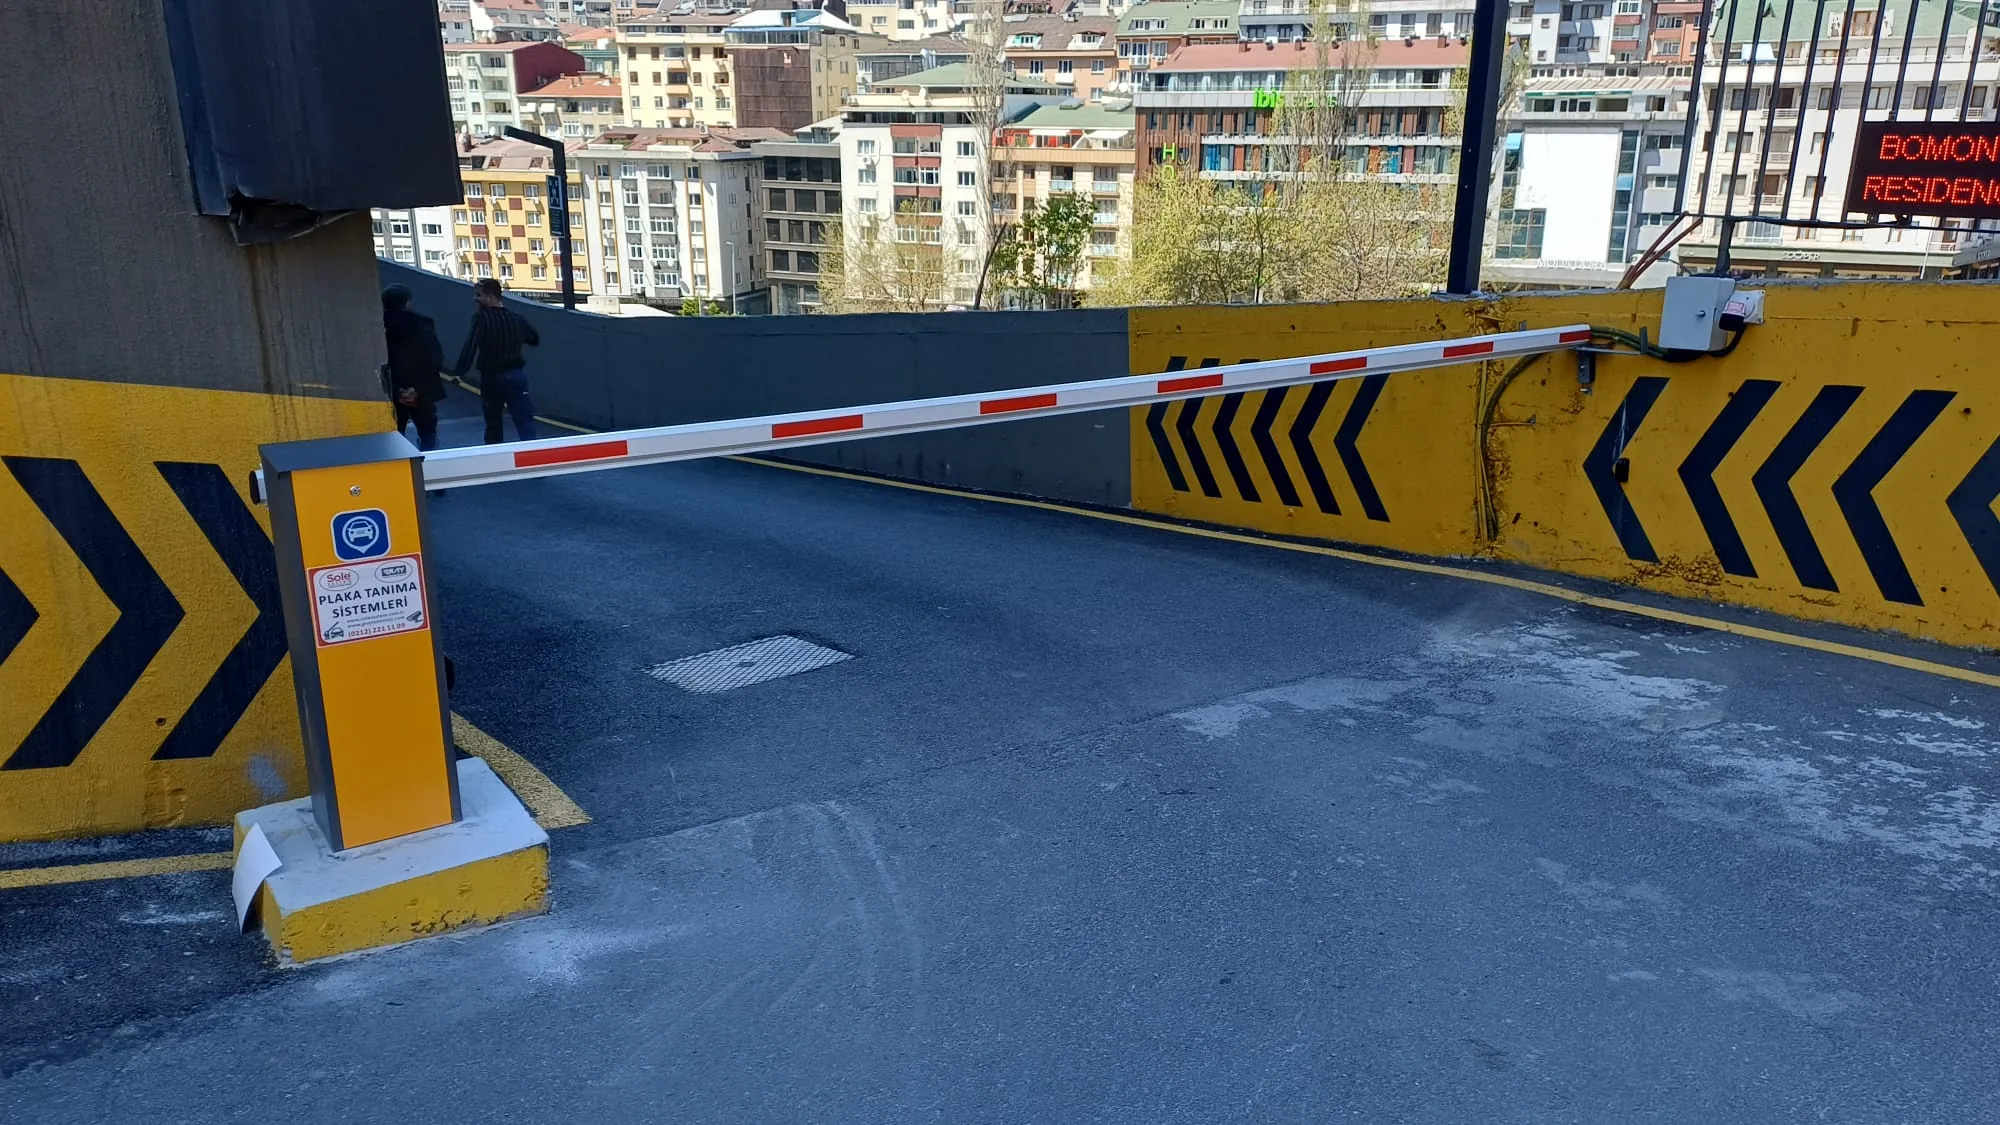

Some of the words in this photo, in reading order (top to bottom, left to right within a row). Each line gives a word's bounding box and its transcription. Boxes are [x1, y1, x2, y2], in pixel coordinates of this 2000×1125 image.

[1879, 135, 1999, 162] BOMON
[327, 573, 351, 582] Sole
[319, 590, 361, 605] PLAKA
[365, 582, 417, 597] TANIMA
[333, 596, 407, 618] SİSTEMLERİ
[372, 625, 386, 634] 221
